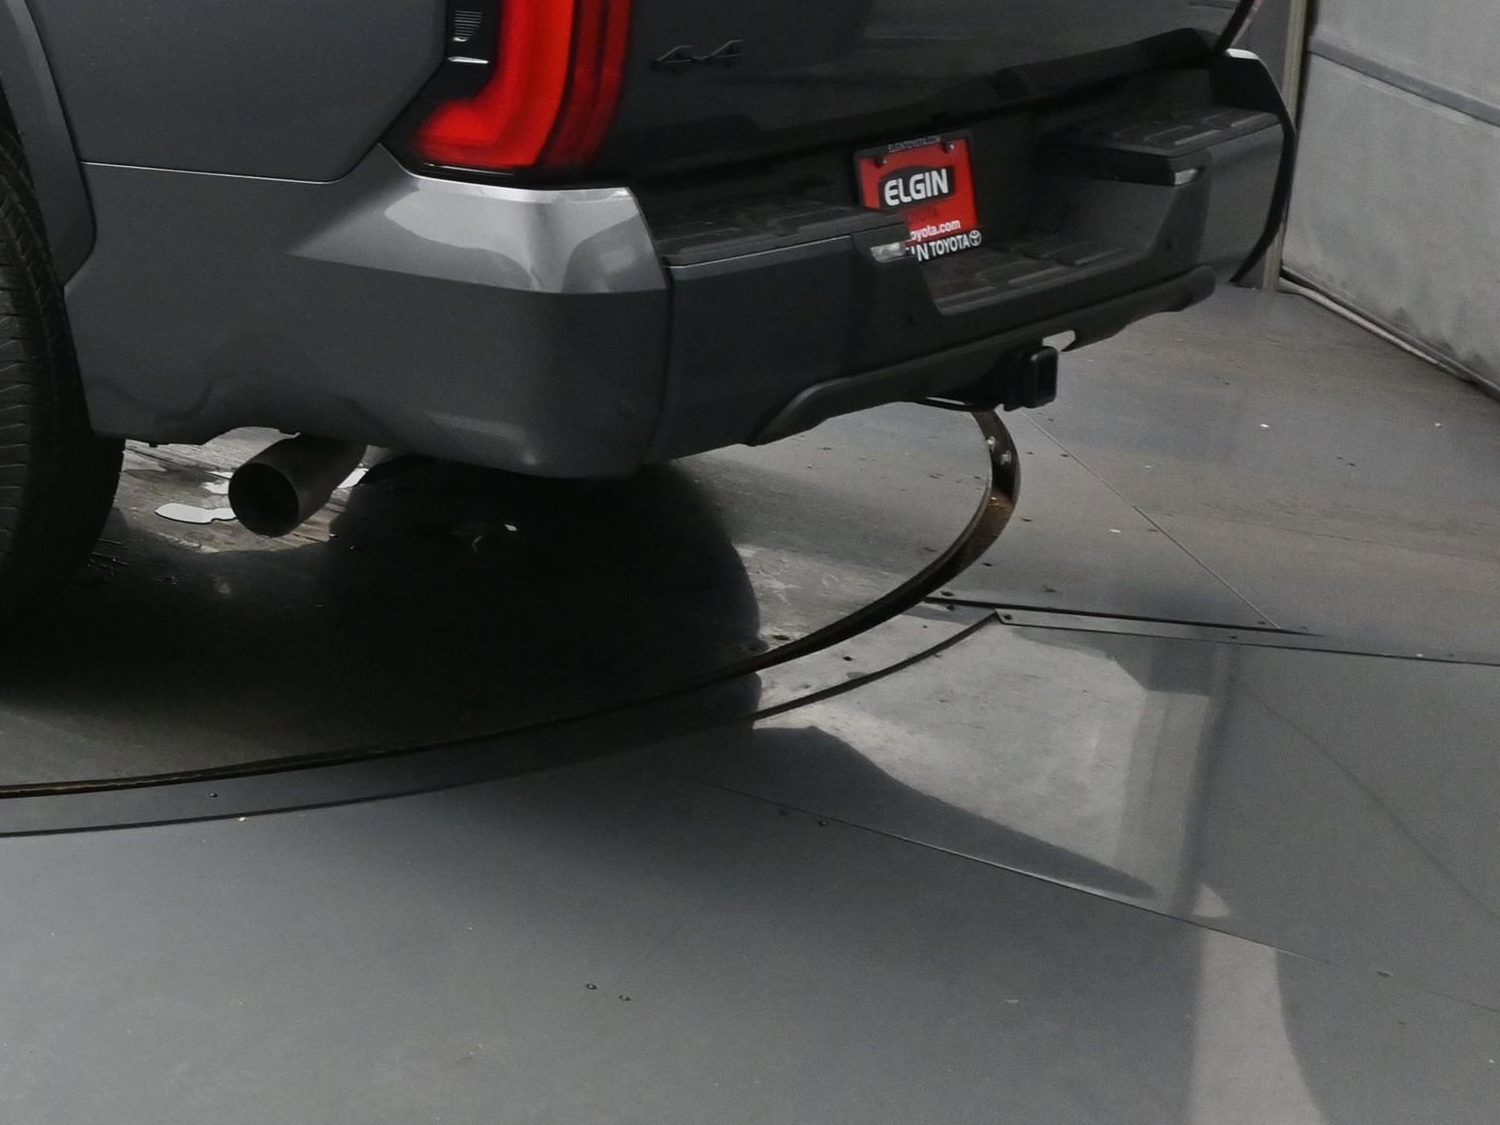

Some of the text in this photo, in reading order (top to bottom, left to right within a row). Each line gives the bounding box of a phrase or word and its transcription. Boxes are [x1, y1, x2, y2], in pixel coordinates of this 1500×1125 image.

[883, 167, 949, 207] ELGIN
[907, 219, 961, 242] oyota.com
[928, 233, 971, 257] TOYOTA
